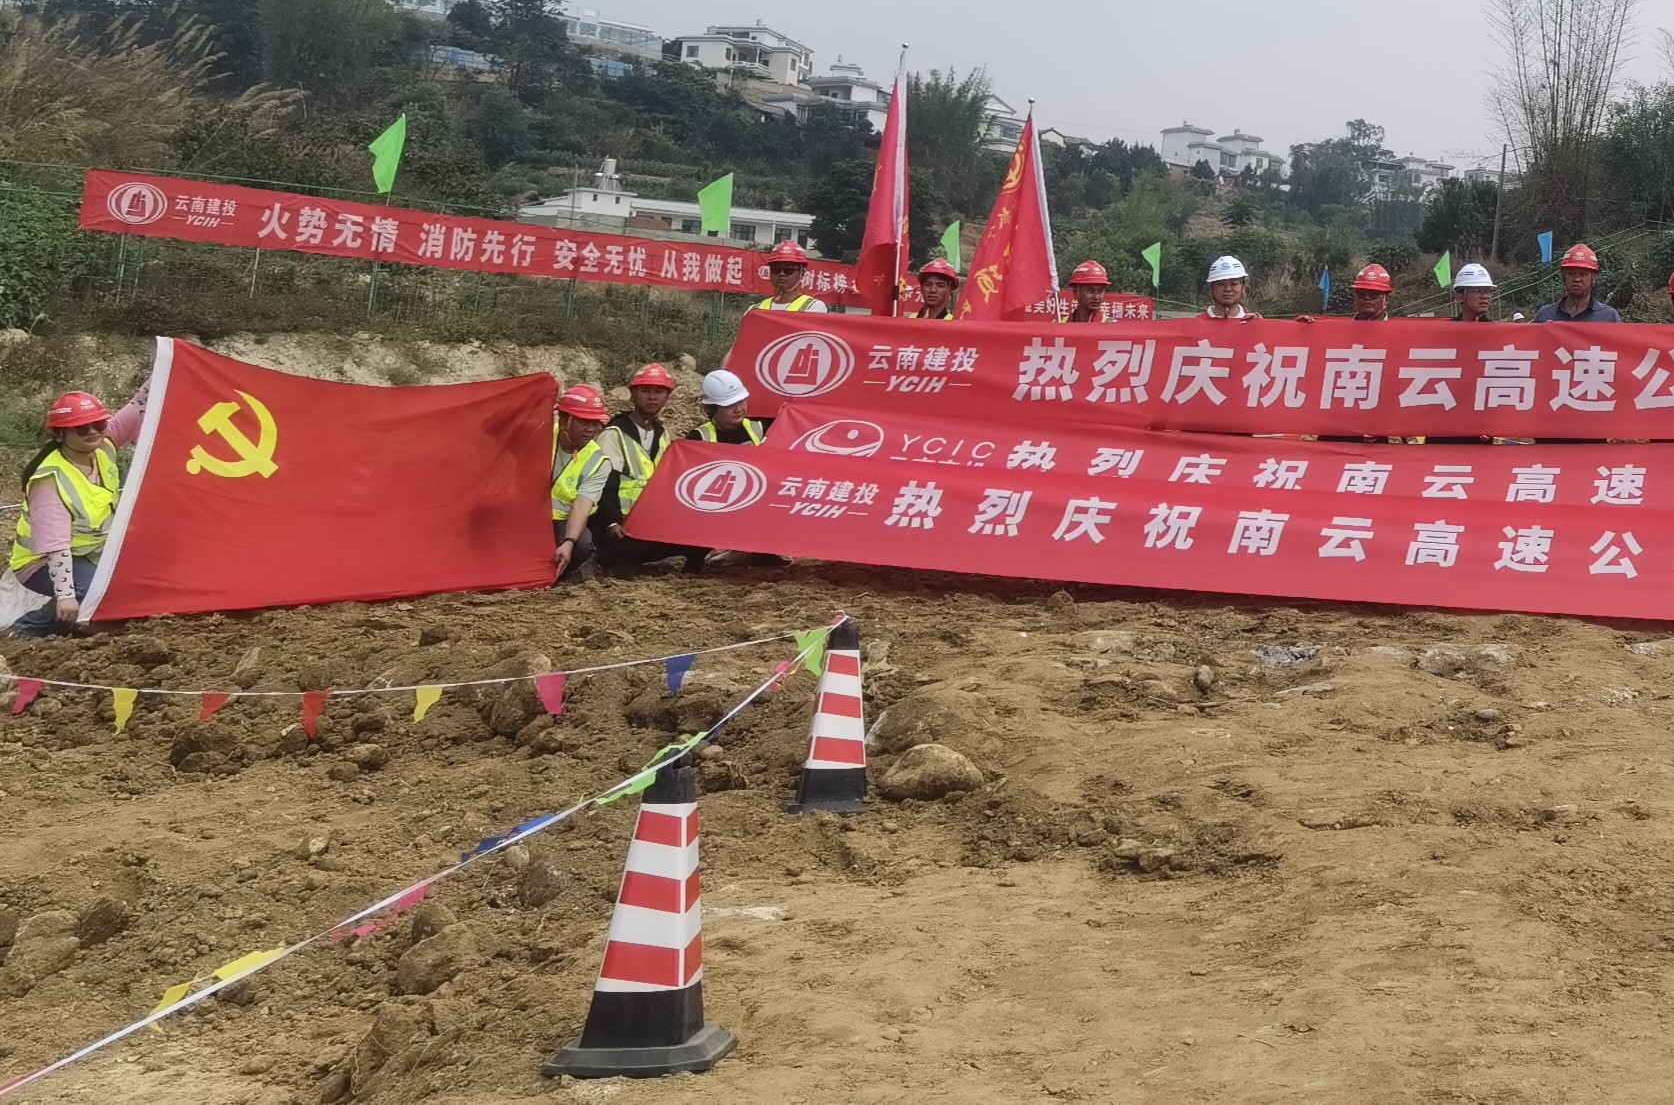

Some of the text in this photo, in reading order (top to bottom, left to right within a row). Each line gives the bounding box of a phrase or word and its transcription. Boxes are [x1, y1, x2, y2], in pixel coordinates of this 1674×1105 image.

[175, 195, 238, 217] 云南建投
[186, 214, 220, 228] YCIH
[257, 202, 743, 285] 火势无情 消防先行 安全无忧 从我做起
[868, 345, 979, 373] 云南建投
[886, 375, 947, 393] YCIH
[901, 433, 996, 459] YCIC
[777, 476, 880, 505] 云南建投
[790, 501, 848, 519] YCIH
